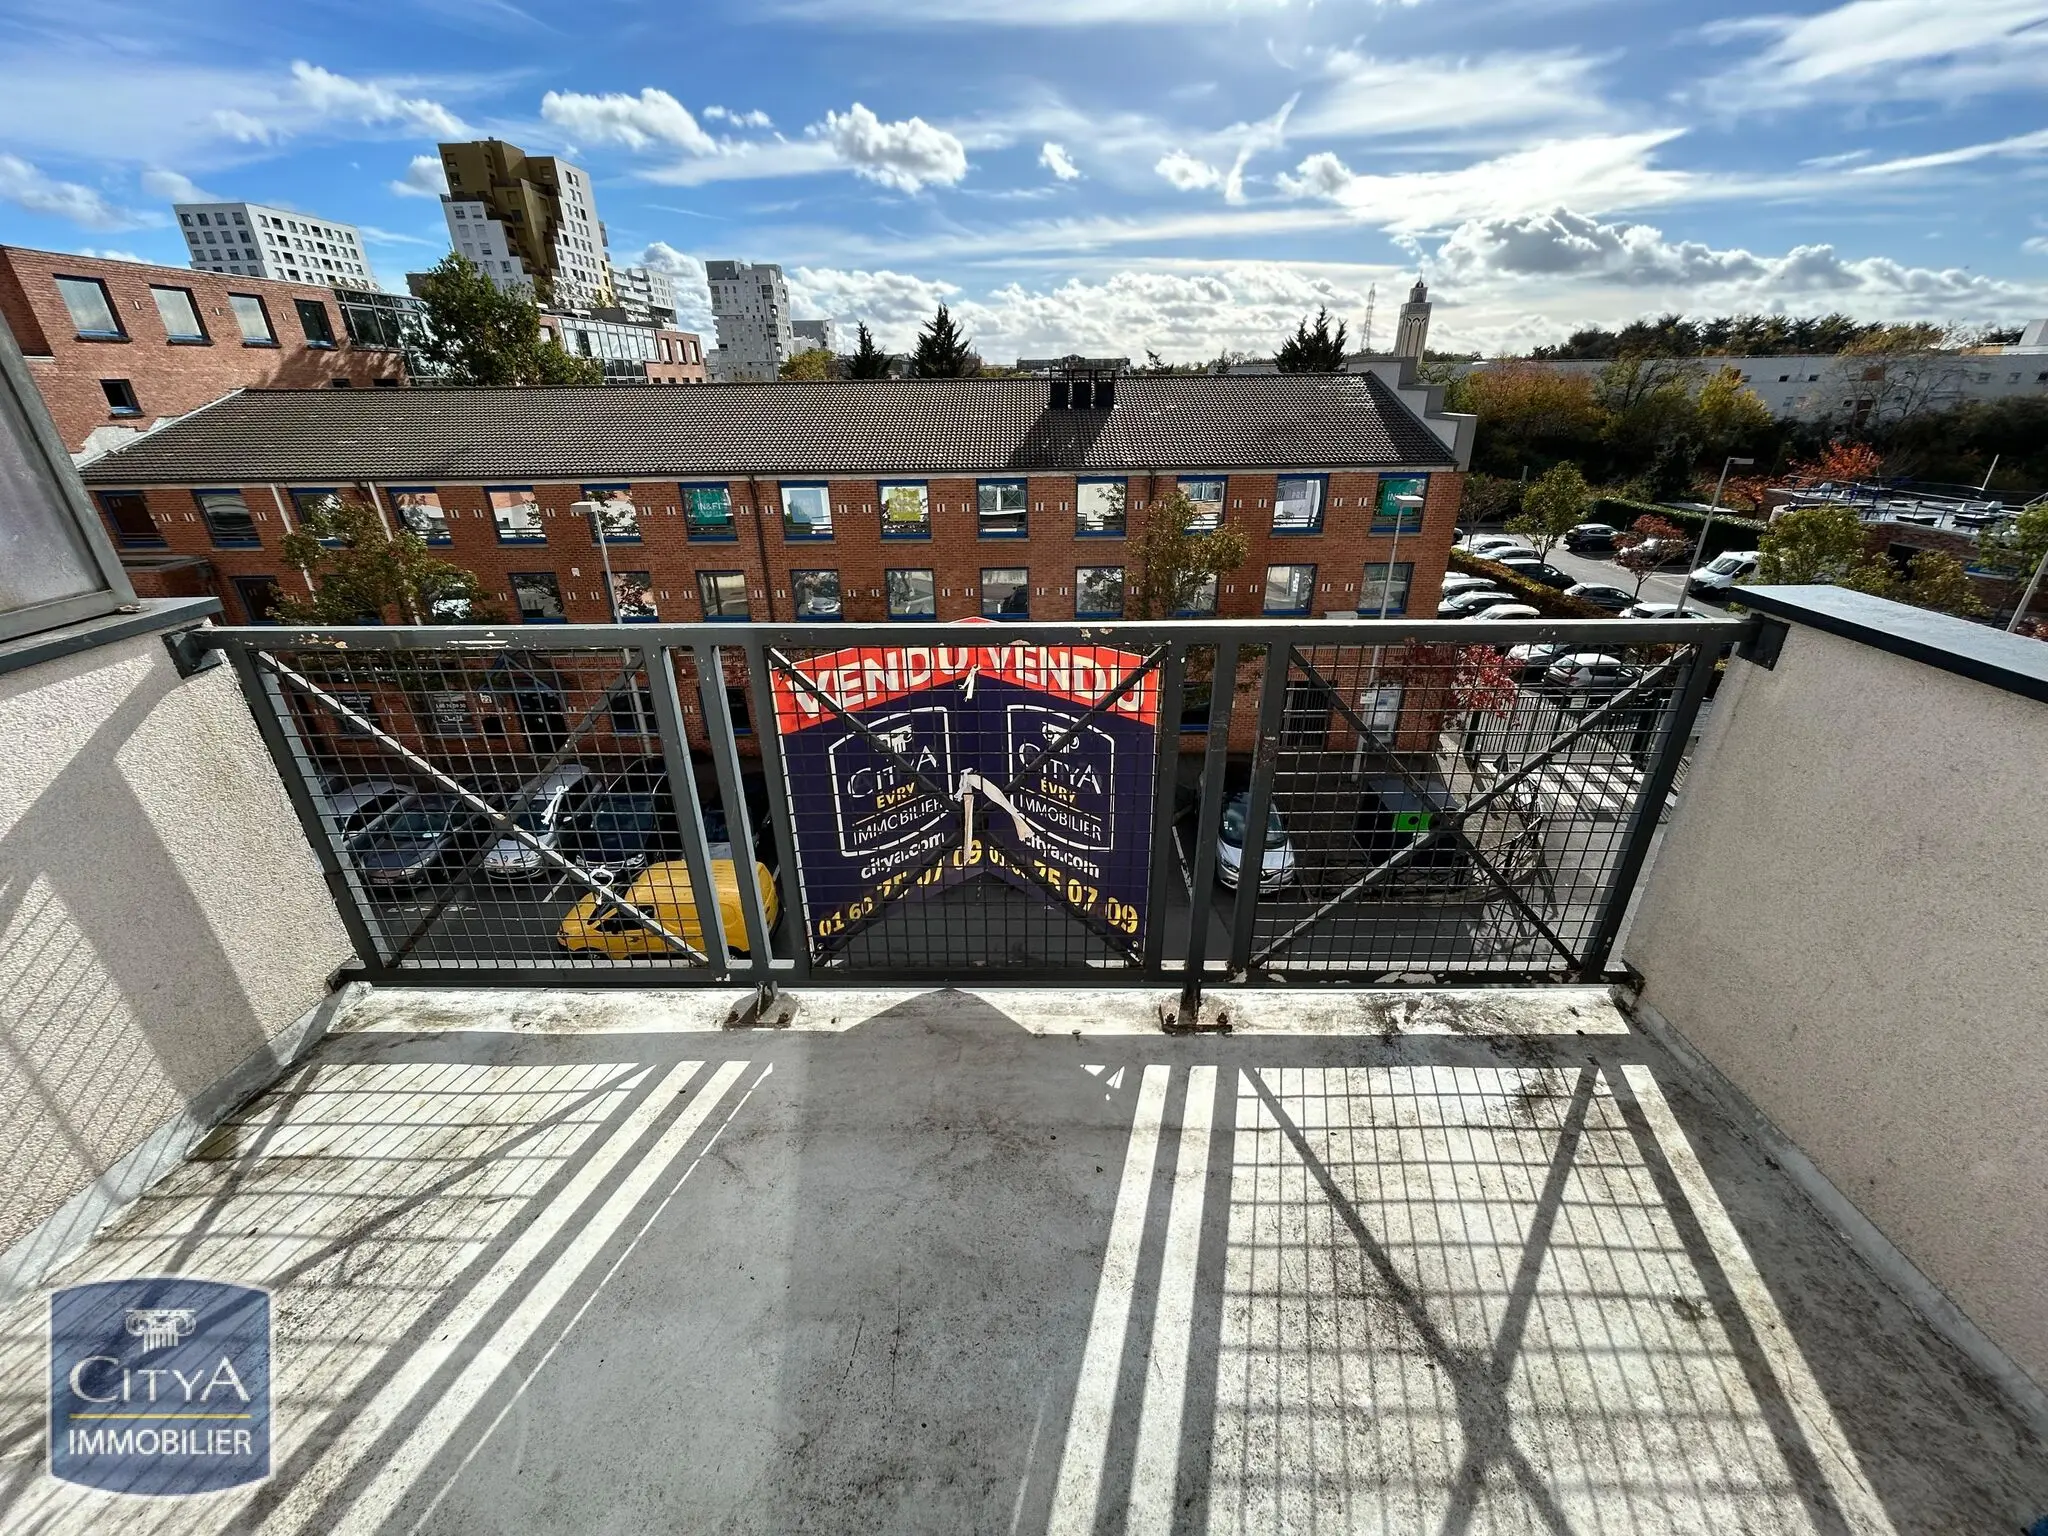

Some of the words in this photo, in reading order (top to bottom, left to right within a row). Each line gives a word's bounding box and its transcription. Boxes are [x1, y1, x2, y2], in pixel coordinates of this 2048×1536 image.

[787, 647, 968, 719] VENDU
[987, 647, 1145, 712] VENDU
[1020, 794, 1102, 841] IMMOBILIER
[861, 832, 945, 879] citya.com
[818, 911, 845, 936] 01
[1067, 878, 1099, 912] 07
[1105, 896, 1139, 934] 09
